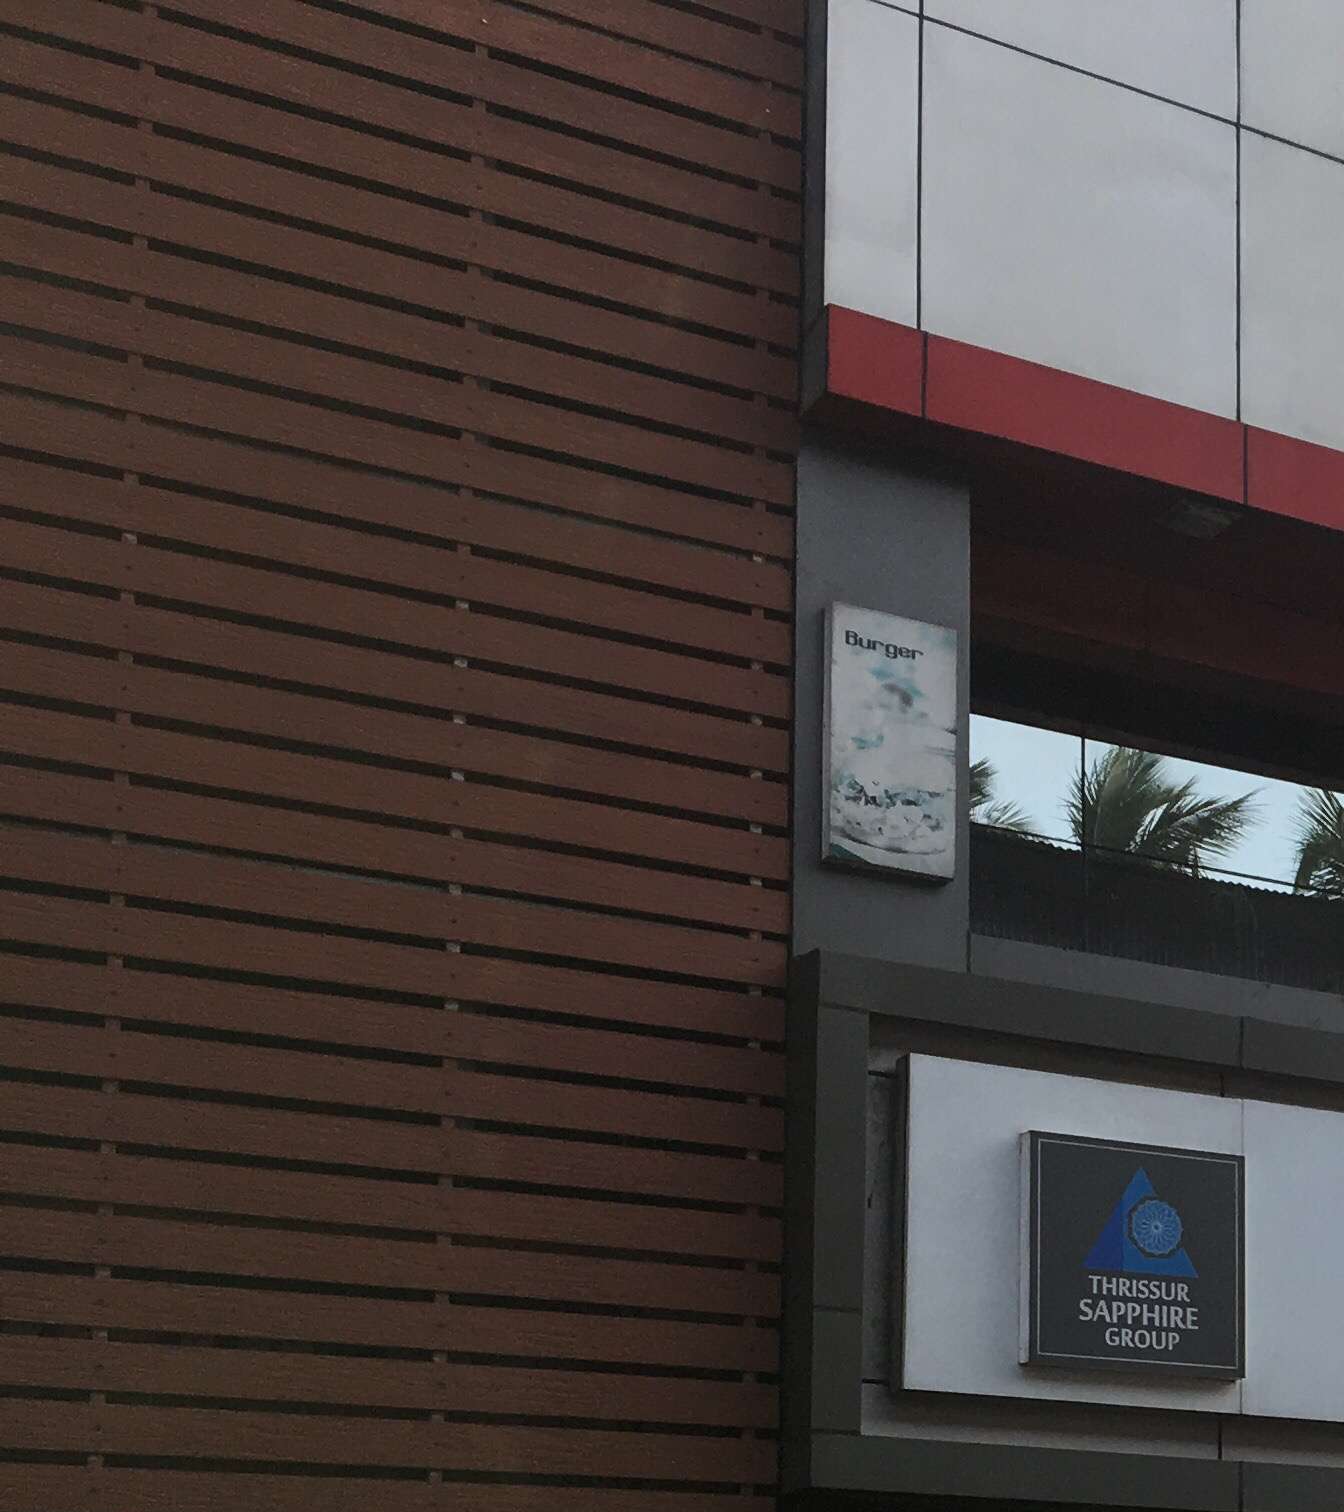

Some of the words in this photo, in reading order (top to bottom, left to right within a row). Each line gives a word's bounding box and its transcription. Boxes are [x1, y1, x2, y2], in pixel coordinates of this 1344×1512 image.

[844, 629, 924, 661] Burger
[1088, 1274, 1190, 1302] THRISSUR
[1079, 1298, 1199, 1330] SAPPHIRE
[1105, 1327, 1180, 1350] GROUP
